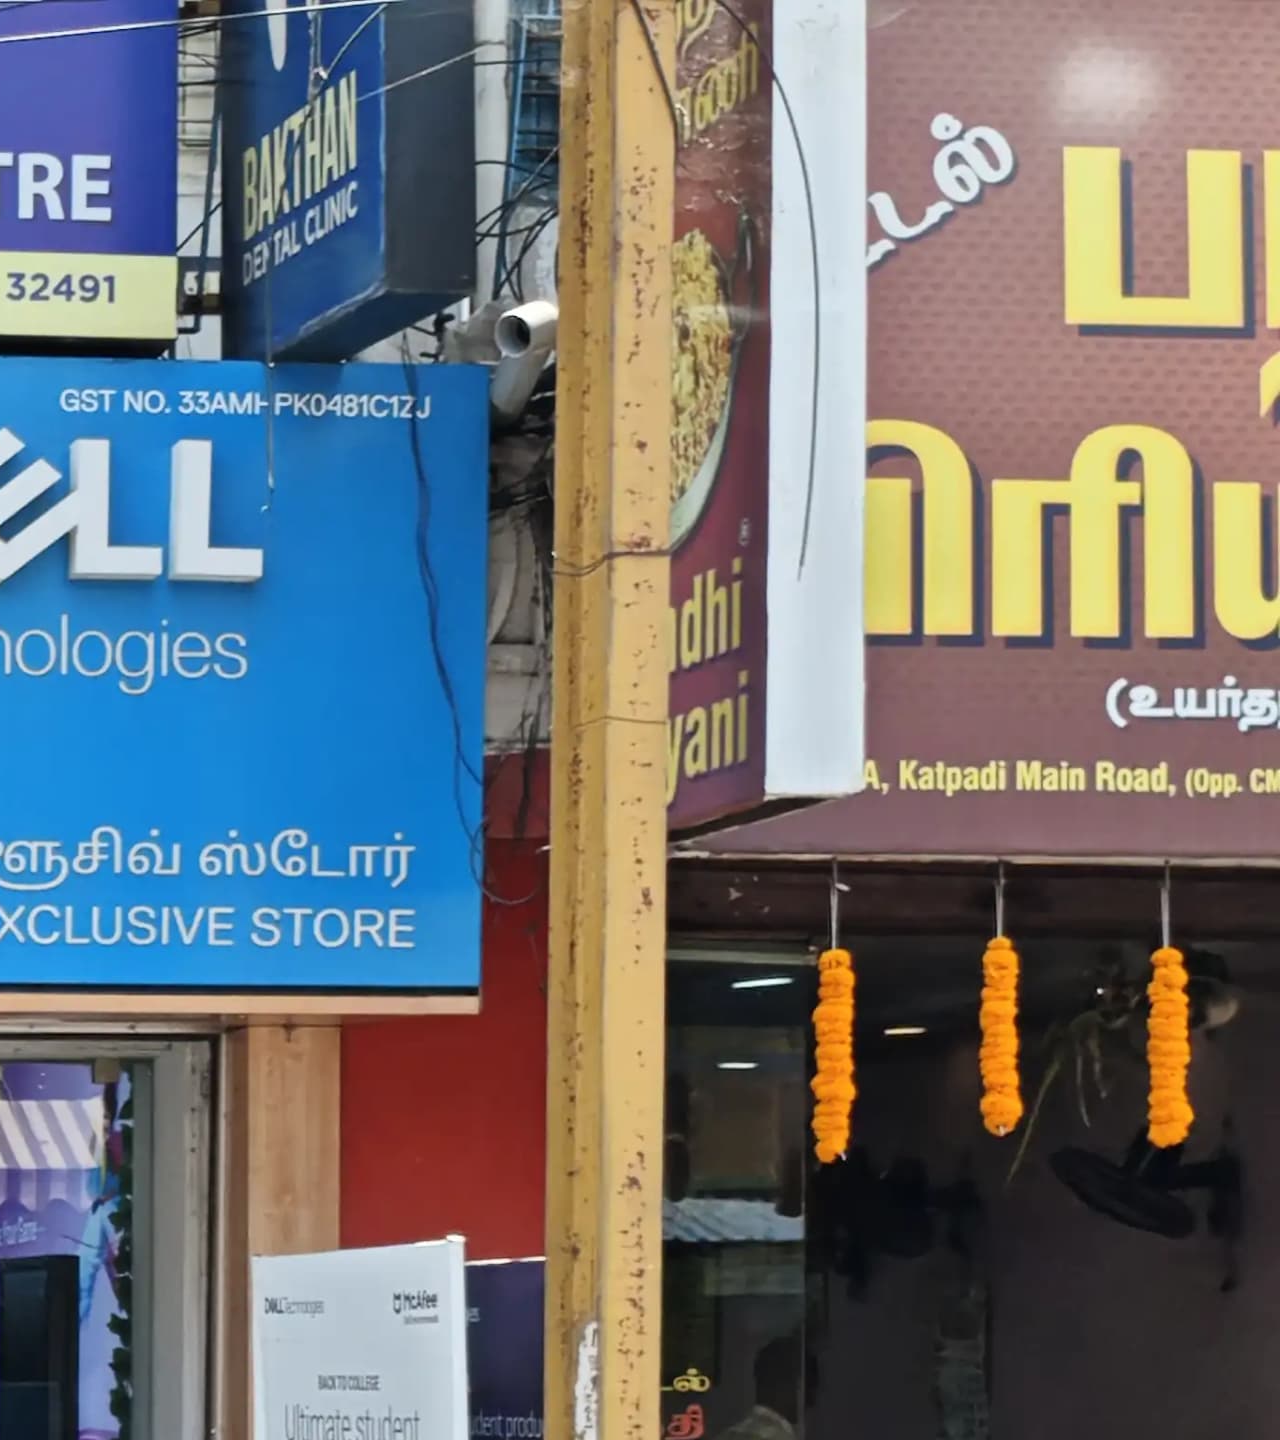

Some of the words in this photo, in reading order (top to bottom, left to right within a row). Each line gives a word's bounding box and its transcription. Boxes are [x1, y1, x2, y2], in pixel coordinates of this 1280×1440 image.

[243, 69, 358, 241] BAKTHAN
[304, 180, 359, 247] CLINIC
[6, 275, 117, 305] 32491
[58, 389, 117, 415] GST
[122, 389, 172, 417] NO.
[899, 760, 1006, 797] Katpadi
[1016, 761, 1087, 792] Main
[1095, 763, 1176, 797] Road,
[1185, 768, 1244, 798] (Opp.
[198, 828, 417, 889] ஸ்டோர்
[250, 906, 417, 949] STORE
